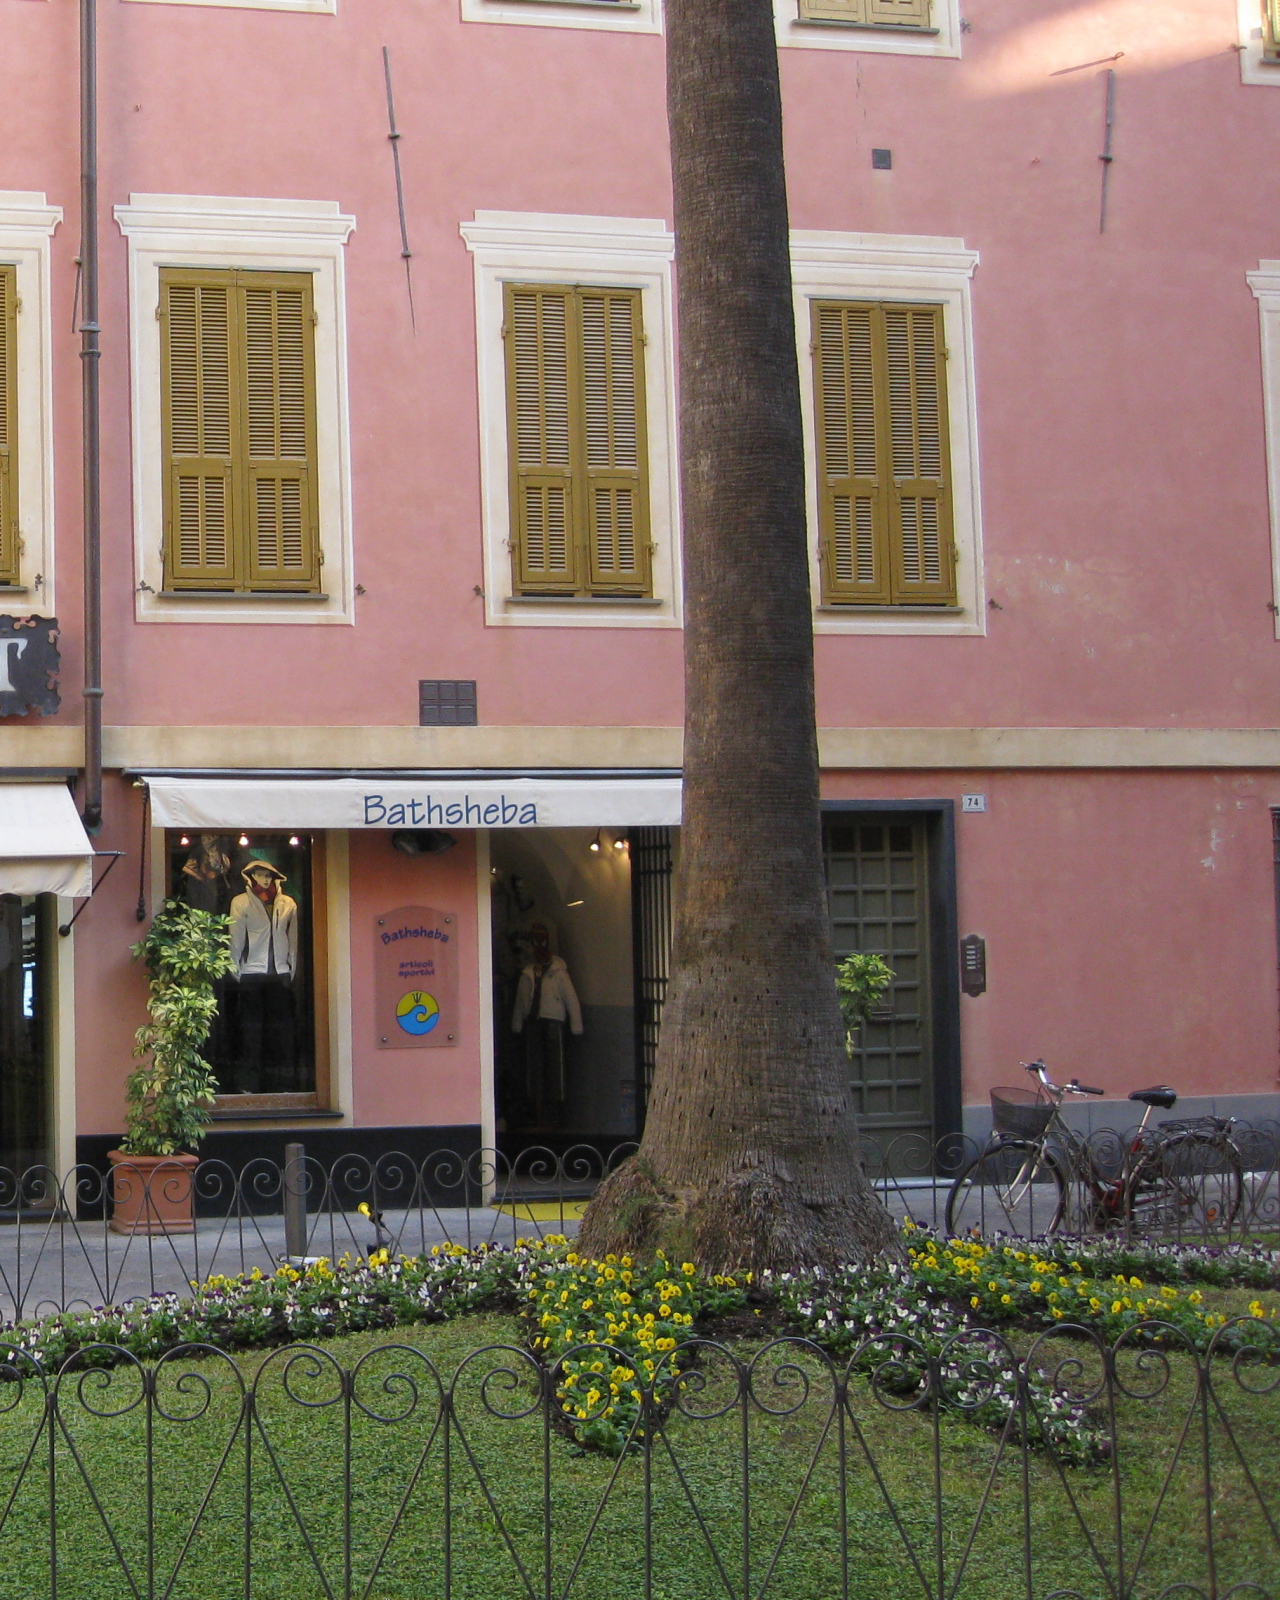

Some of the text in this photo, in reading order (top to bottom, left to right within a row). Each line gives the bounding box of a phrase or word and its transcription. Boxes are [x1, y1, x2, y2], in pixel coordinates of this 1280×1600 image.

[967, 797, 979, 807] 74
[364, 794, 537, 825] Bathsheba
[381, 926, 449, 945] Bathsheba
[399, 960, 434, 969] articoli
[398, 969, 435, 979] sportivi
